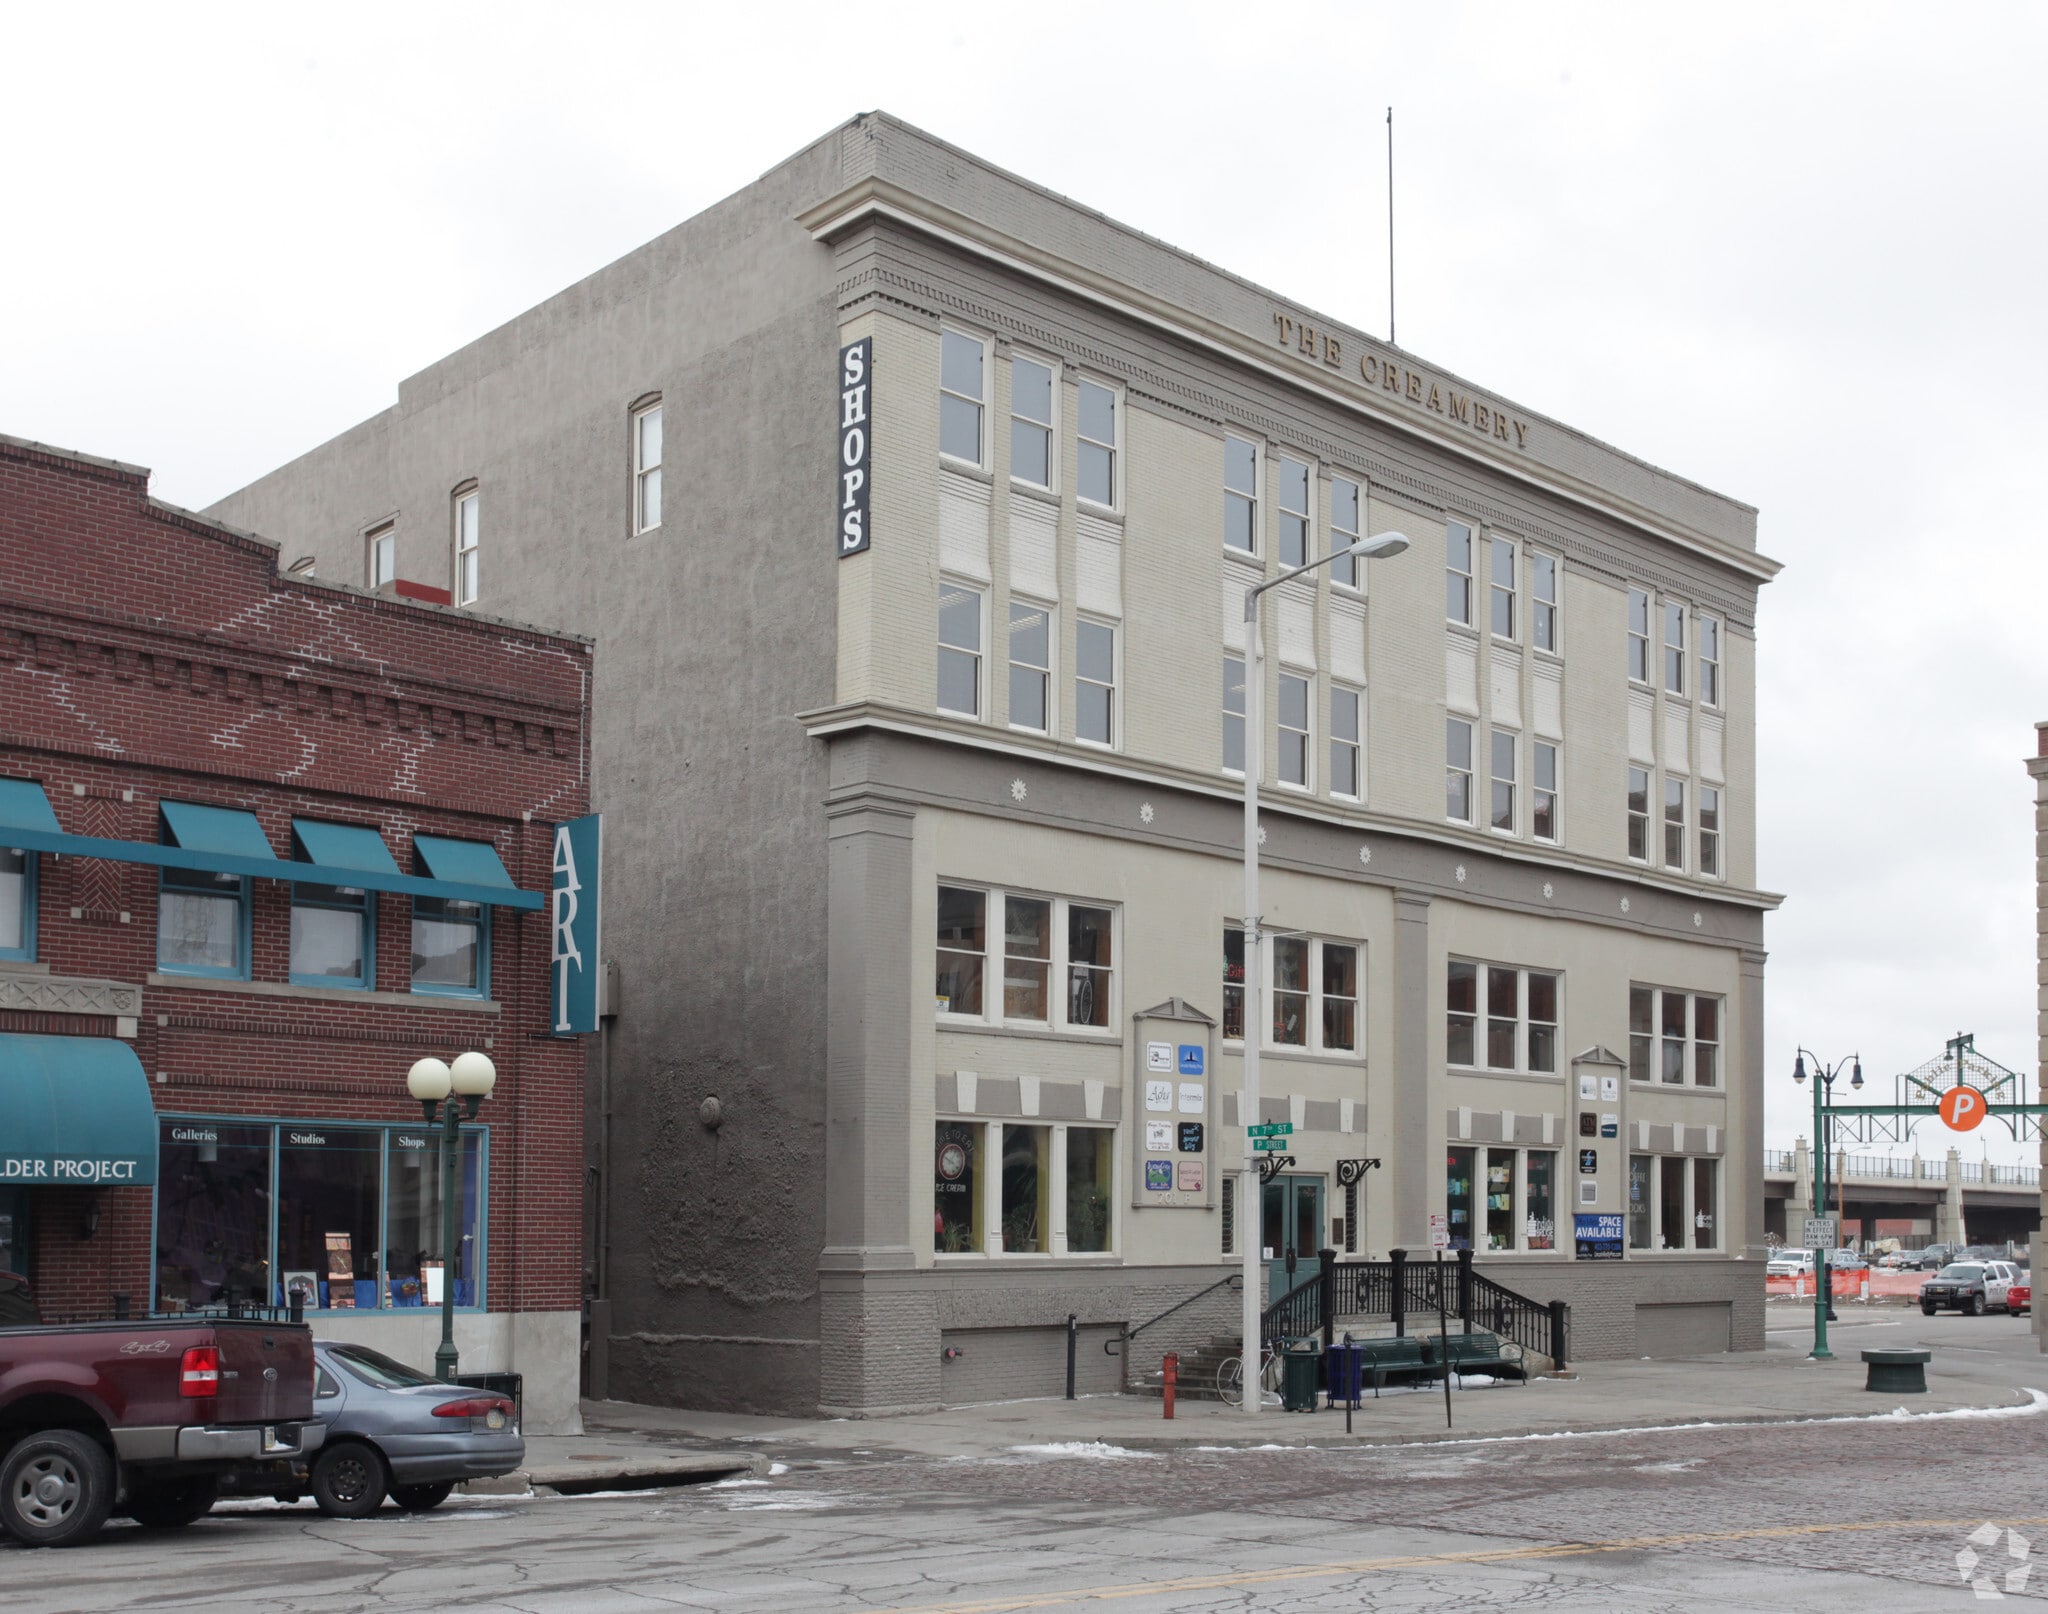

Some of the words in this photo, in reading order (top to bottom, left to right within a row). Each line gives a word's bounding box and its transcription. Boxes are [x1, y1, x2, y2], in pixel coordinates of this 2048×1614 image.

[1273, 312, 1344, 369] THE
[1360, 352, 1530, 449] CREAMERY
[842, 344, 867, 551] SHOPS
[552, 826, 583, 1032] ART
[1915, 1063, 1952, 1100] Public
[1959, 1059, 2006, 1100] Parking
[1952, 1094, 1975, 1124] P
[172, 1128, 217, 1141] Galleries
[1252, 1127, 1258, 1136] N
[1277, 1124, 1287, 1134] ST
[290, 1132, 325, 1145] Studios
[398, 1136, 425, 1149] Shops
[1257, 1140, 1263, 1149] P
[1266, 1140, 1283, 1150] STREET
[53, 1160, 137, 1183] PROJECT
[1598, 1216, 1622, 1227] SPACE
[1576, 1227, 1622, 1238] AVAILABLE
